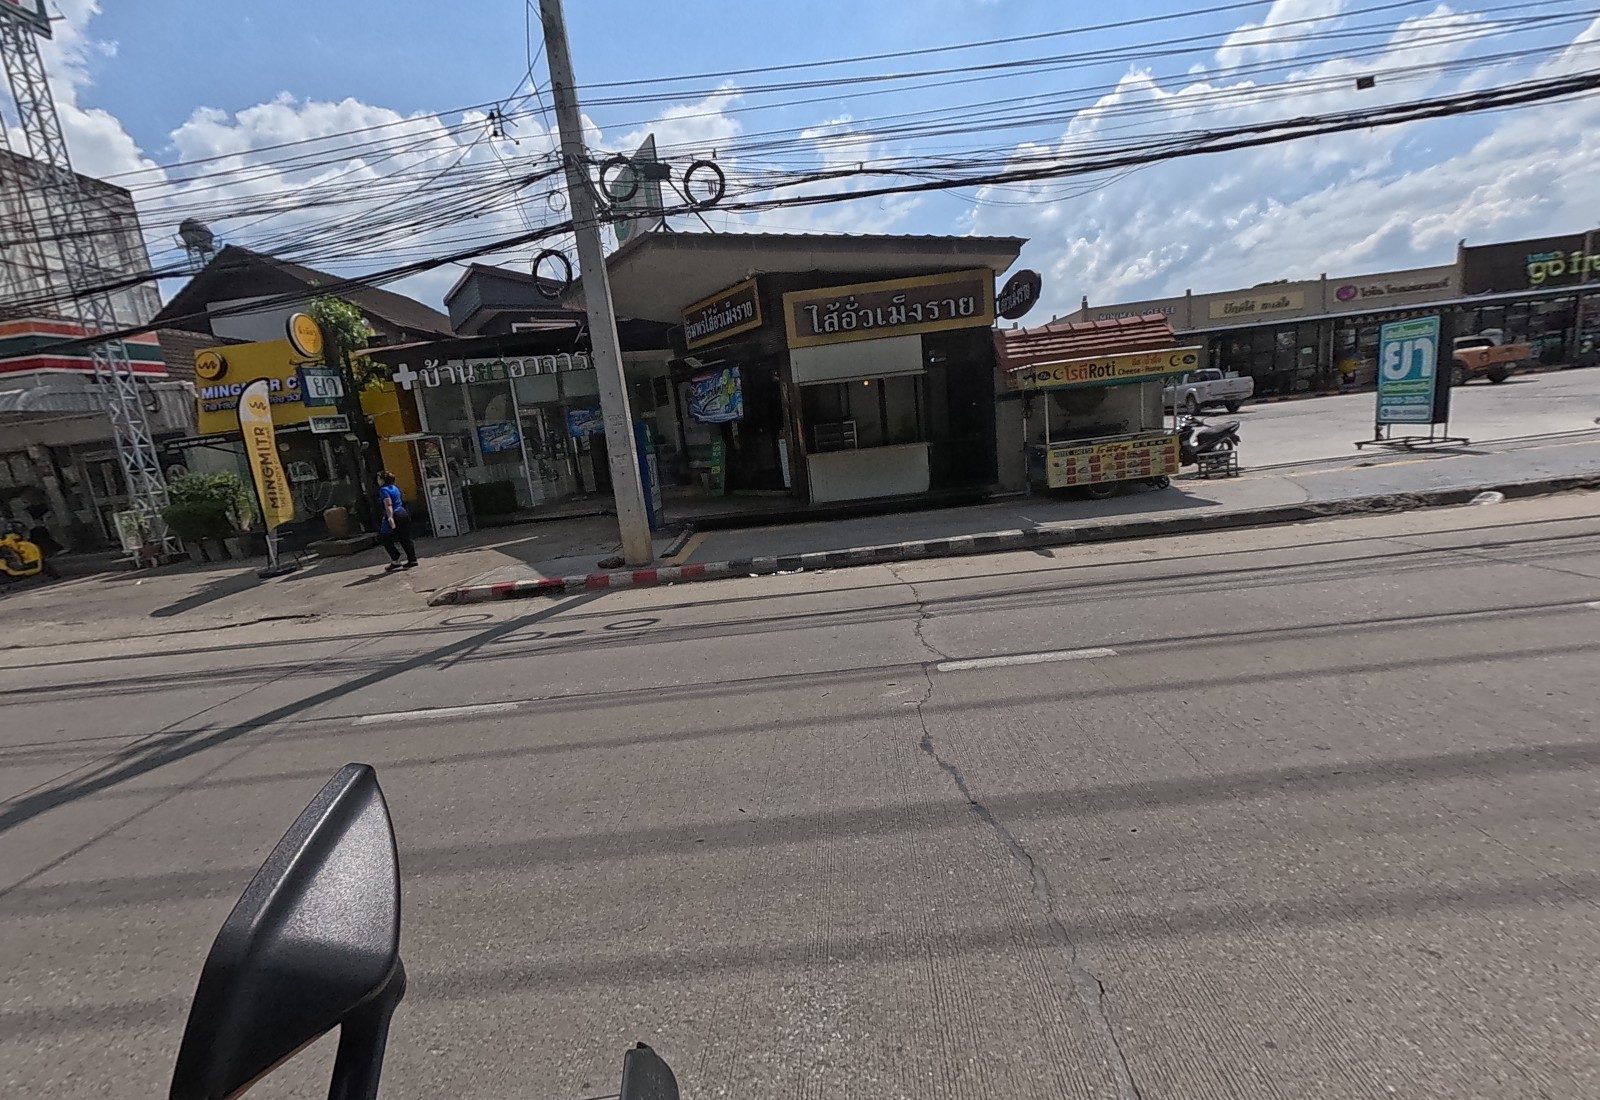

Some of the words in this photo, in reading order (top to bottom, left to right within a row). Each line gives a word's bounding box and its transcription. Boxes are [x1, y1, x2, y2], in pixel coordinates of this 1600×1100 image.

[1527, 260, 1565, 284] go
[804, 295, 975, 334] ไส้อั่วเม็งราย
[420, 350, 588, 389] บ้านยาอาจาร
[1088, 361, 1116, 379] Roti
[1384, 338, 1434, 380] ยา
[254, 426, 279, 509] MINGMITR
